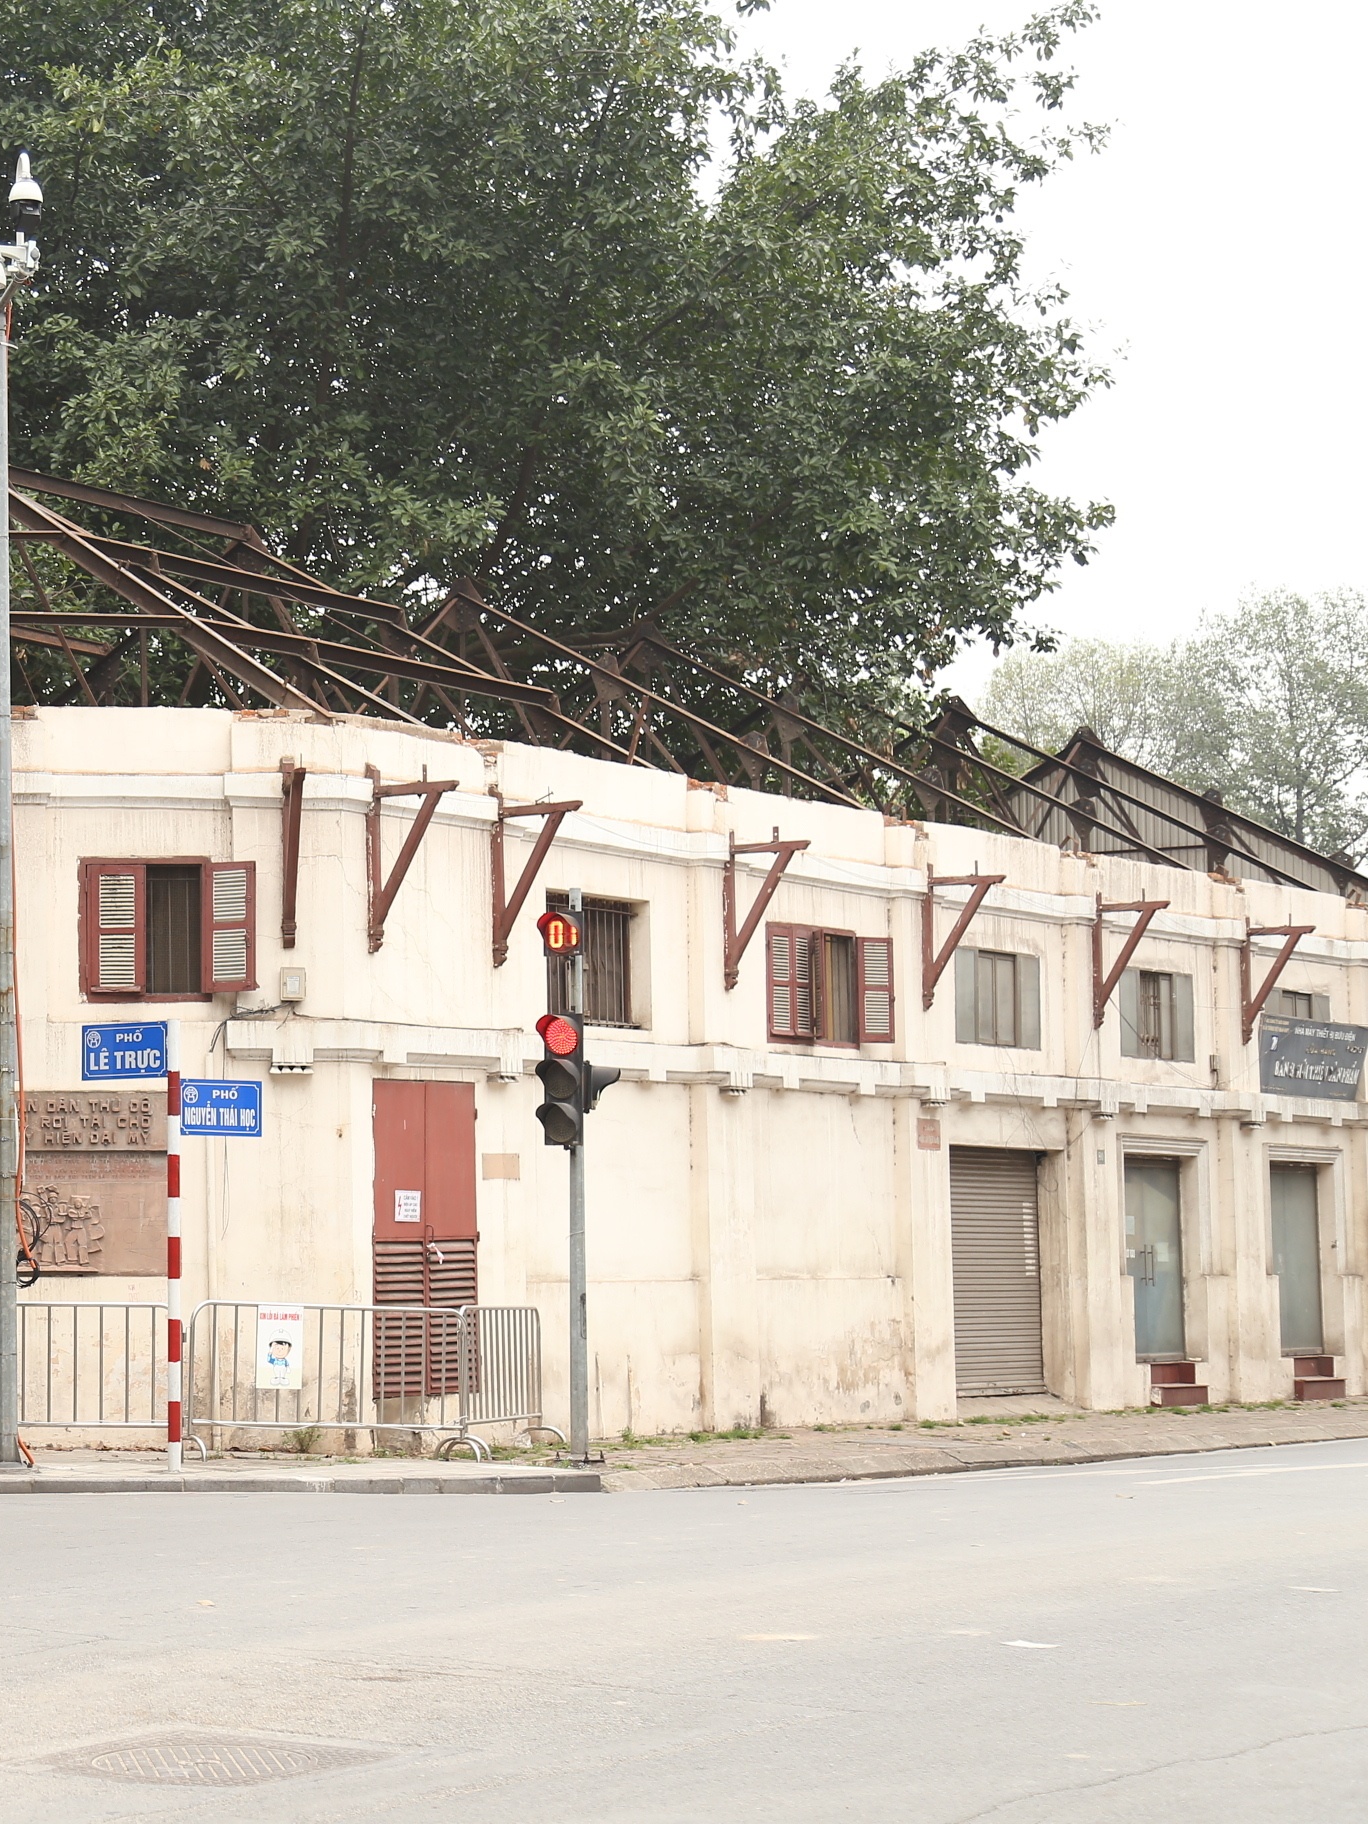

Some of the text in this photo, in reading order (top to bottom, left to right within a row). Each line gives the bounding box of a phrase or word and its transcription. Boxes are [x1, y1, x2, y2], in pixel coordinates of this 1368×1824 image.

[116, 1028, 144, 1043] PHỐ
[89, 1047, 161, 1073] LÊ TRỰC
[212, 1086, 239, 1100] PHỐ
[184, 1101, 256, 1131] NGUYỄN THÁI HỌC
